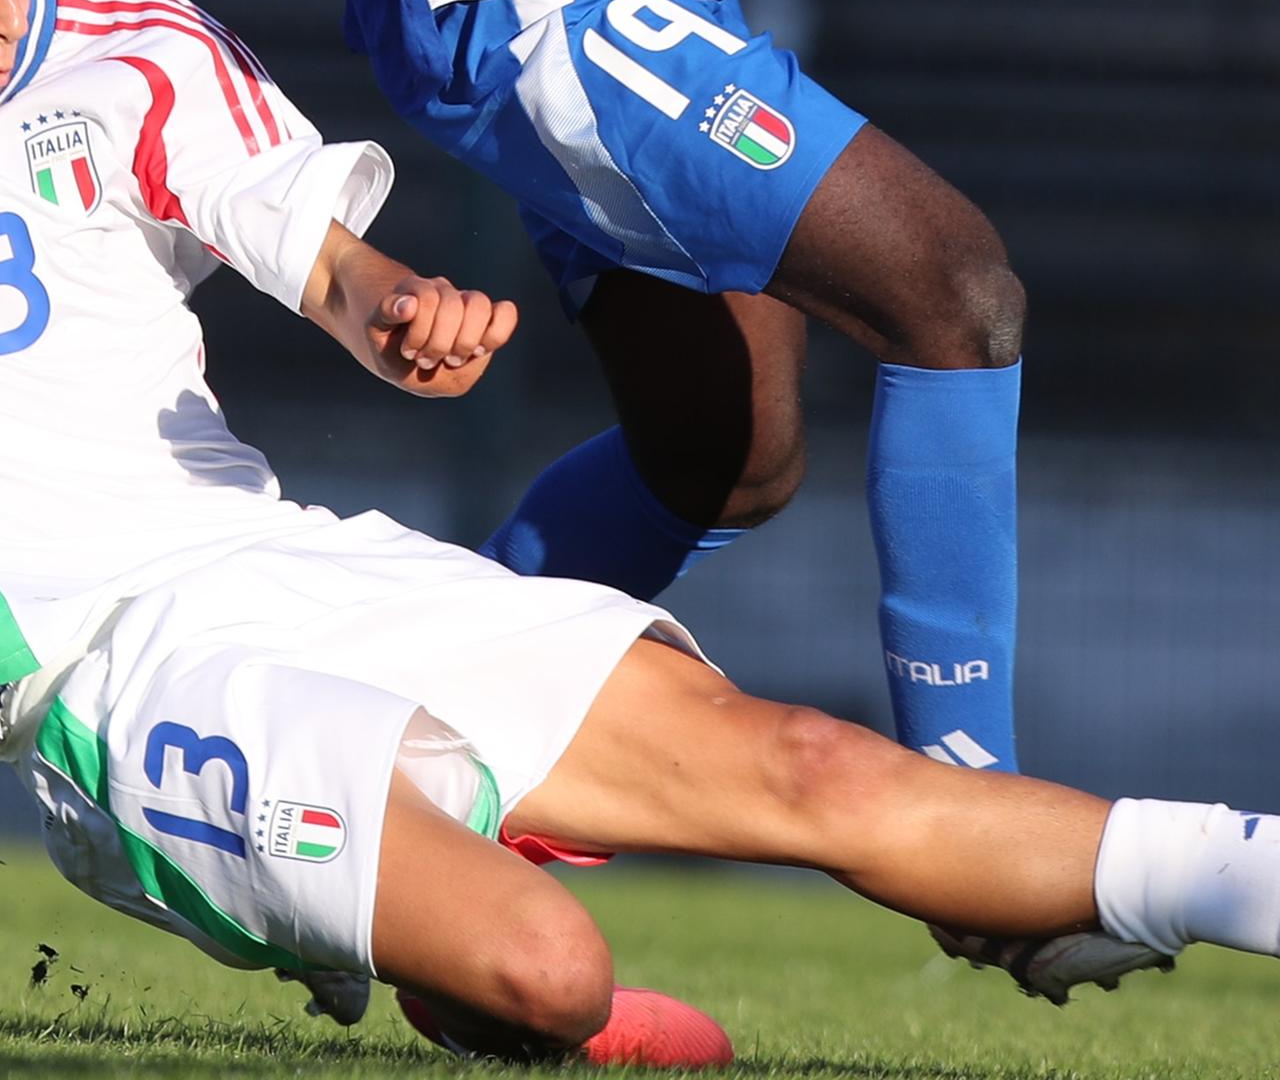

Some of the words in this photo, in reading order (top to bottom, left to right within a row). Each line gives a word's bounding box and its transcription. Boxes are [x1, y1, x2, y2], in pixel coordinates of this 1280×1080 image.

[716, 98, 754, 142] ITALIA
[31, 130, 83, 160] ITALIA
[142, 721, 249, 859] 13
[274, 807, 295, 854] ITALIA
